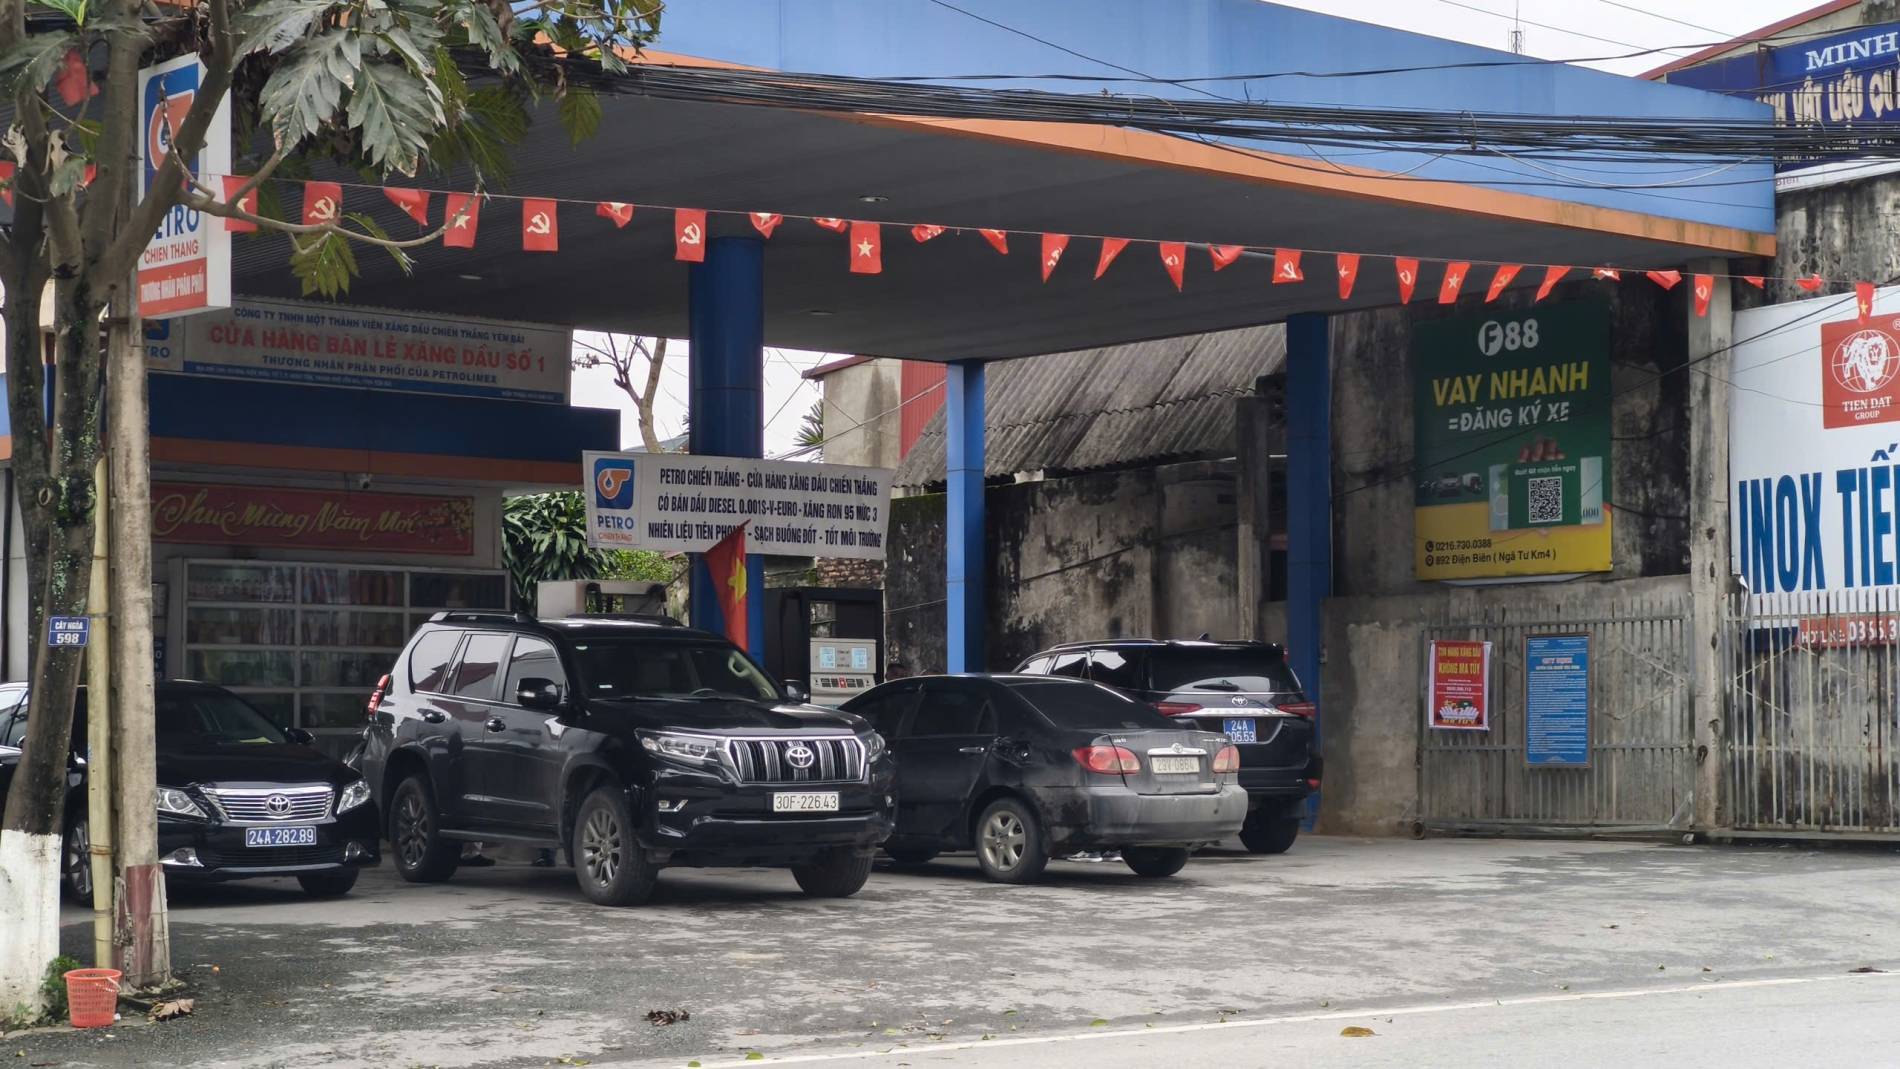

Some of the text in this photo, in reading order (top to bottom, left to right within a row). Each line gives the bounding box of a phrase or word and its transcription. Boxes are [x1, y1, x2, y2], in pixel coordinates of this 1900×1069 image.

[1805, 31, 1899, 70] MINH
[263, 310, 276, 320] TY
[278, 311, 305, 323] TNHH
[1477, 318, 1540, 357] F88
[209, 320, 546, 373] CỬA HÀNG BÁN LẺ XĂNG DẦU SỐ 1
[432, 369, 497, 384] PETROLIMEX
[1432, 361, 1590, 407] VAY NHANH
[1842, 396, 1893, 412] TIEN DAT
[1518, 399, 1542, 426] KÝ
[1547, 401, 1570, 423] XE
[1854, 410, 1880, 420] GROUP
[660, 468, 686, 486] PETRO
[747, 468, 763, 488] CỬA
[708, 497, 737, 514] DIESEL
[826, 504, 842, 520] RON
[844, 505, 855, 521] 95
[873, 507, 878, 522] 3
[597, 514, 634, 530] PETRO
[1738, 471, 1826, 594] INOX
[1531, 549, 1551, 560] Km4
[56, 632, 80, 644] 598
[1231, 719, 1248, 732] 24A
[775, 795, 837, 810] 30F-226.43
[248, 828, 314, 845] 24A-282.89
